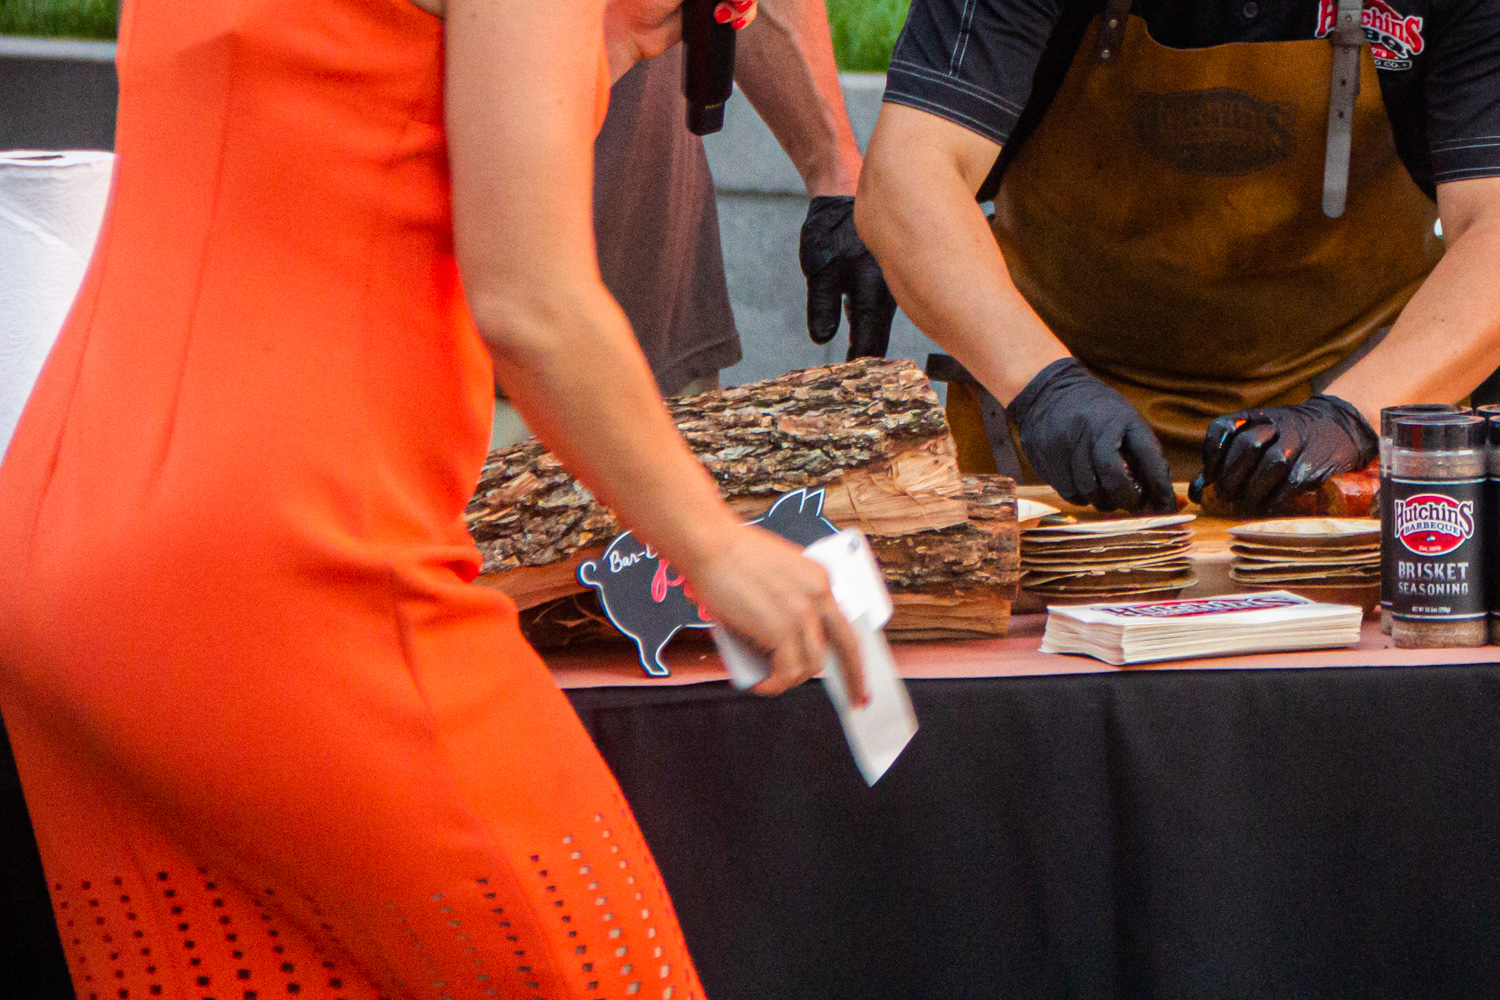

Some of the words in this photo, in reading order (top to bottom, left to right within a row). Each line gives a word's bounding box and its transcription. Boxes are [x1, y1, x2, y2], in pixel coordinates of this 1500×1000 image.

[1404, 521, 1459, 535] BARBEQUE
[1398, 561, 1469, 580] BRISKET
[1398, 582, 1469, 596] SEASONING
